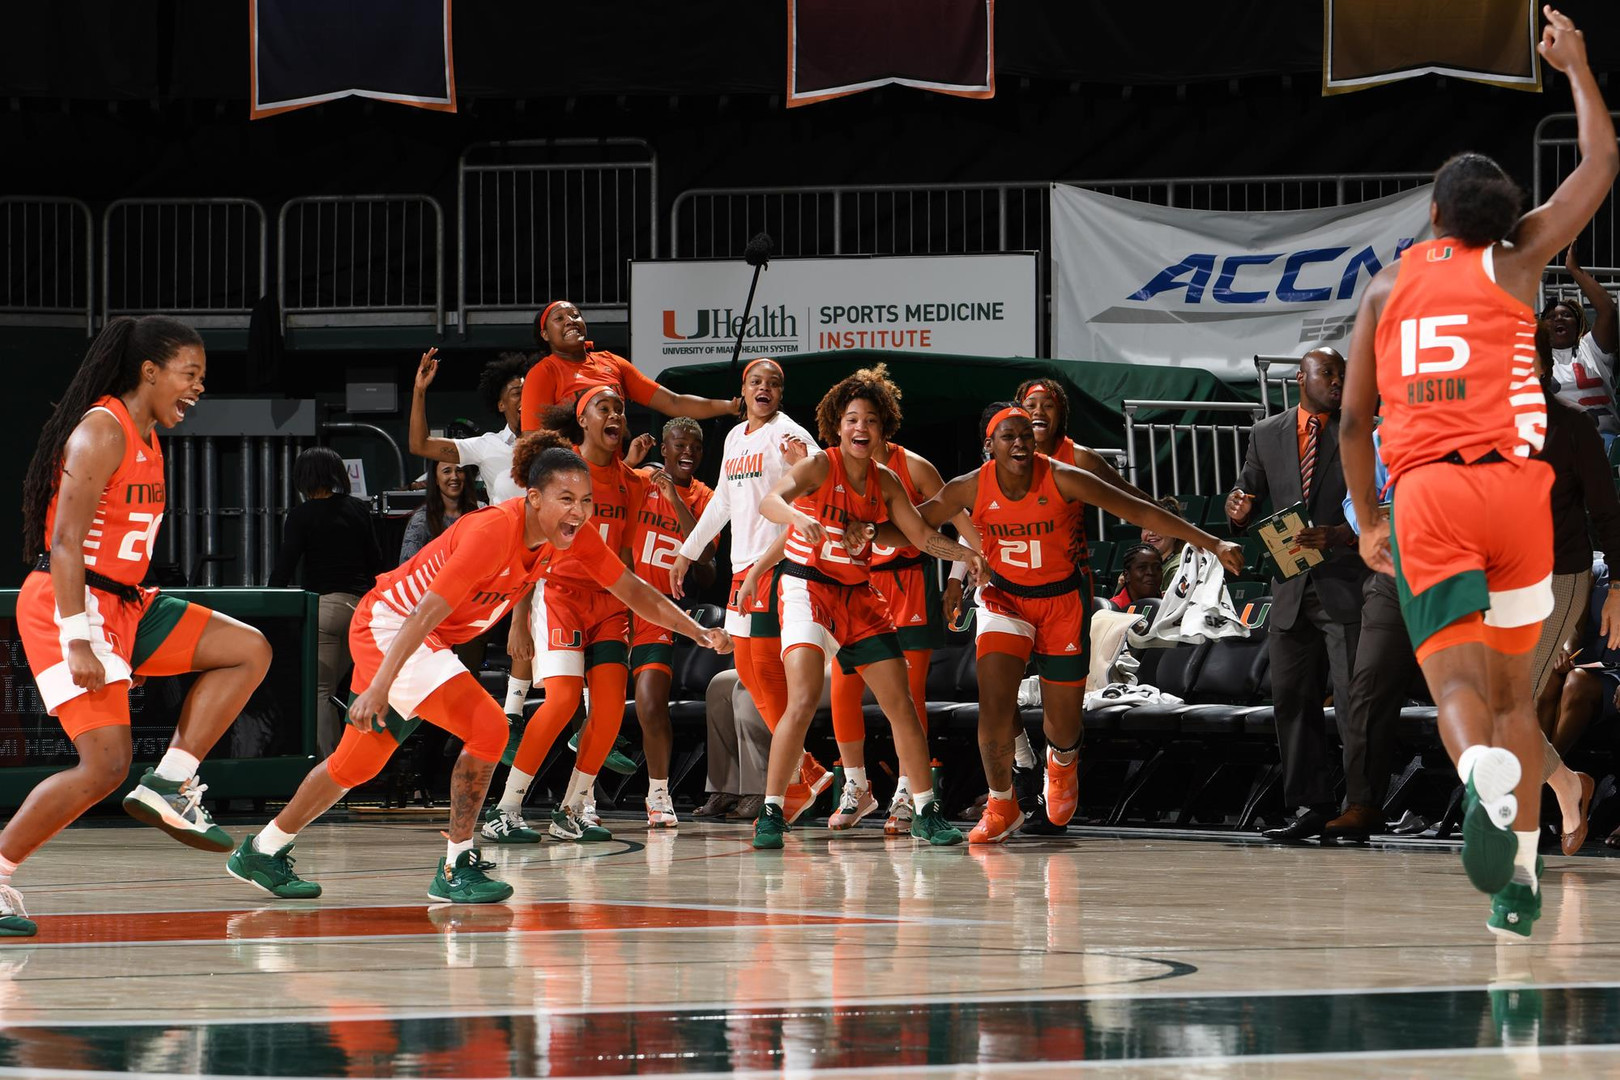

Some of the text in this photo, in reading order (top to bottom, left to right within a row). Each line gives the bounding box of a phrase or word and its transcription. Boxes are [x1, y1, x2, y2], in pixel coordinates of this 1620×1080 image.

[1126, 238, 1414, 304] ACCN
[820, 302, 1004, 324] SPORTS MEDICINE
[662, 344, 799, 355] UNIVERSITY OF MIAM HEALTH SYSTEM
[819, 330, 932, 350] INSTITUTE
[1401, 314, 1470, 377] 15
[1407, 378, 1467, 405] HUSTON
[641, 530, 683, 570] 12
[998, 539, 1042, 569] 21
